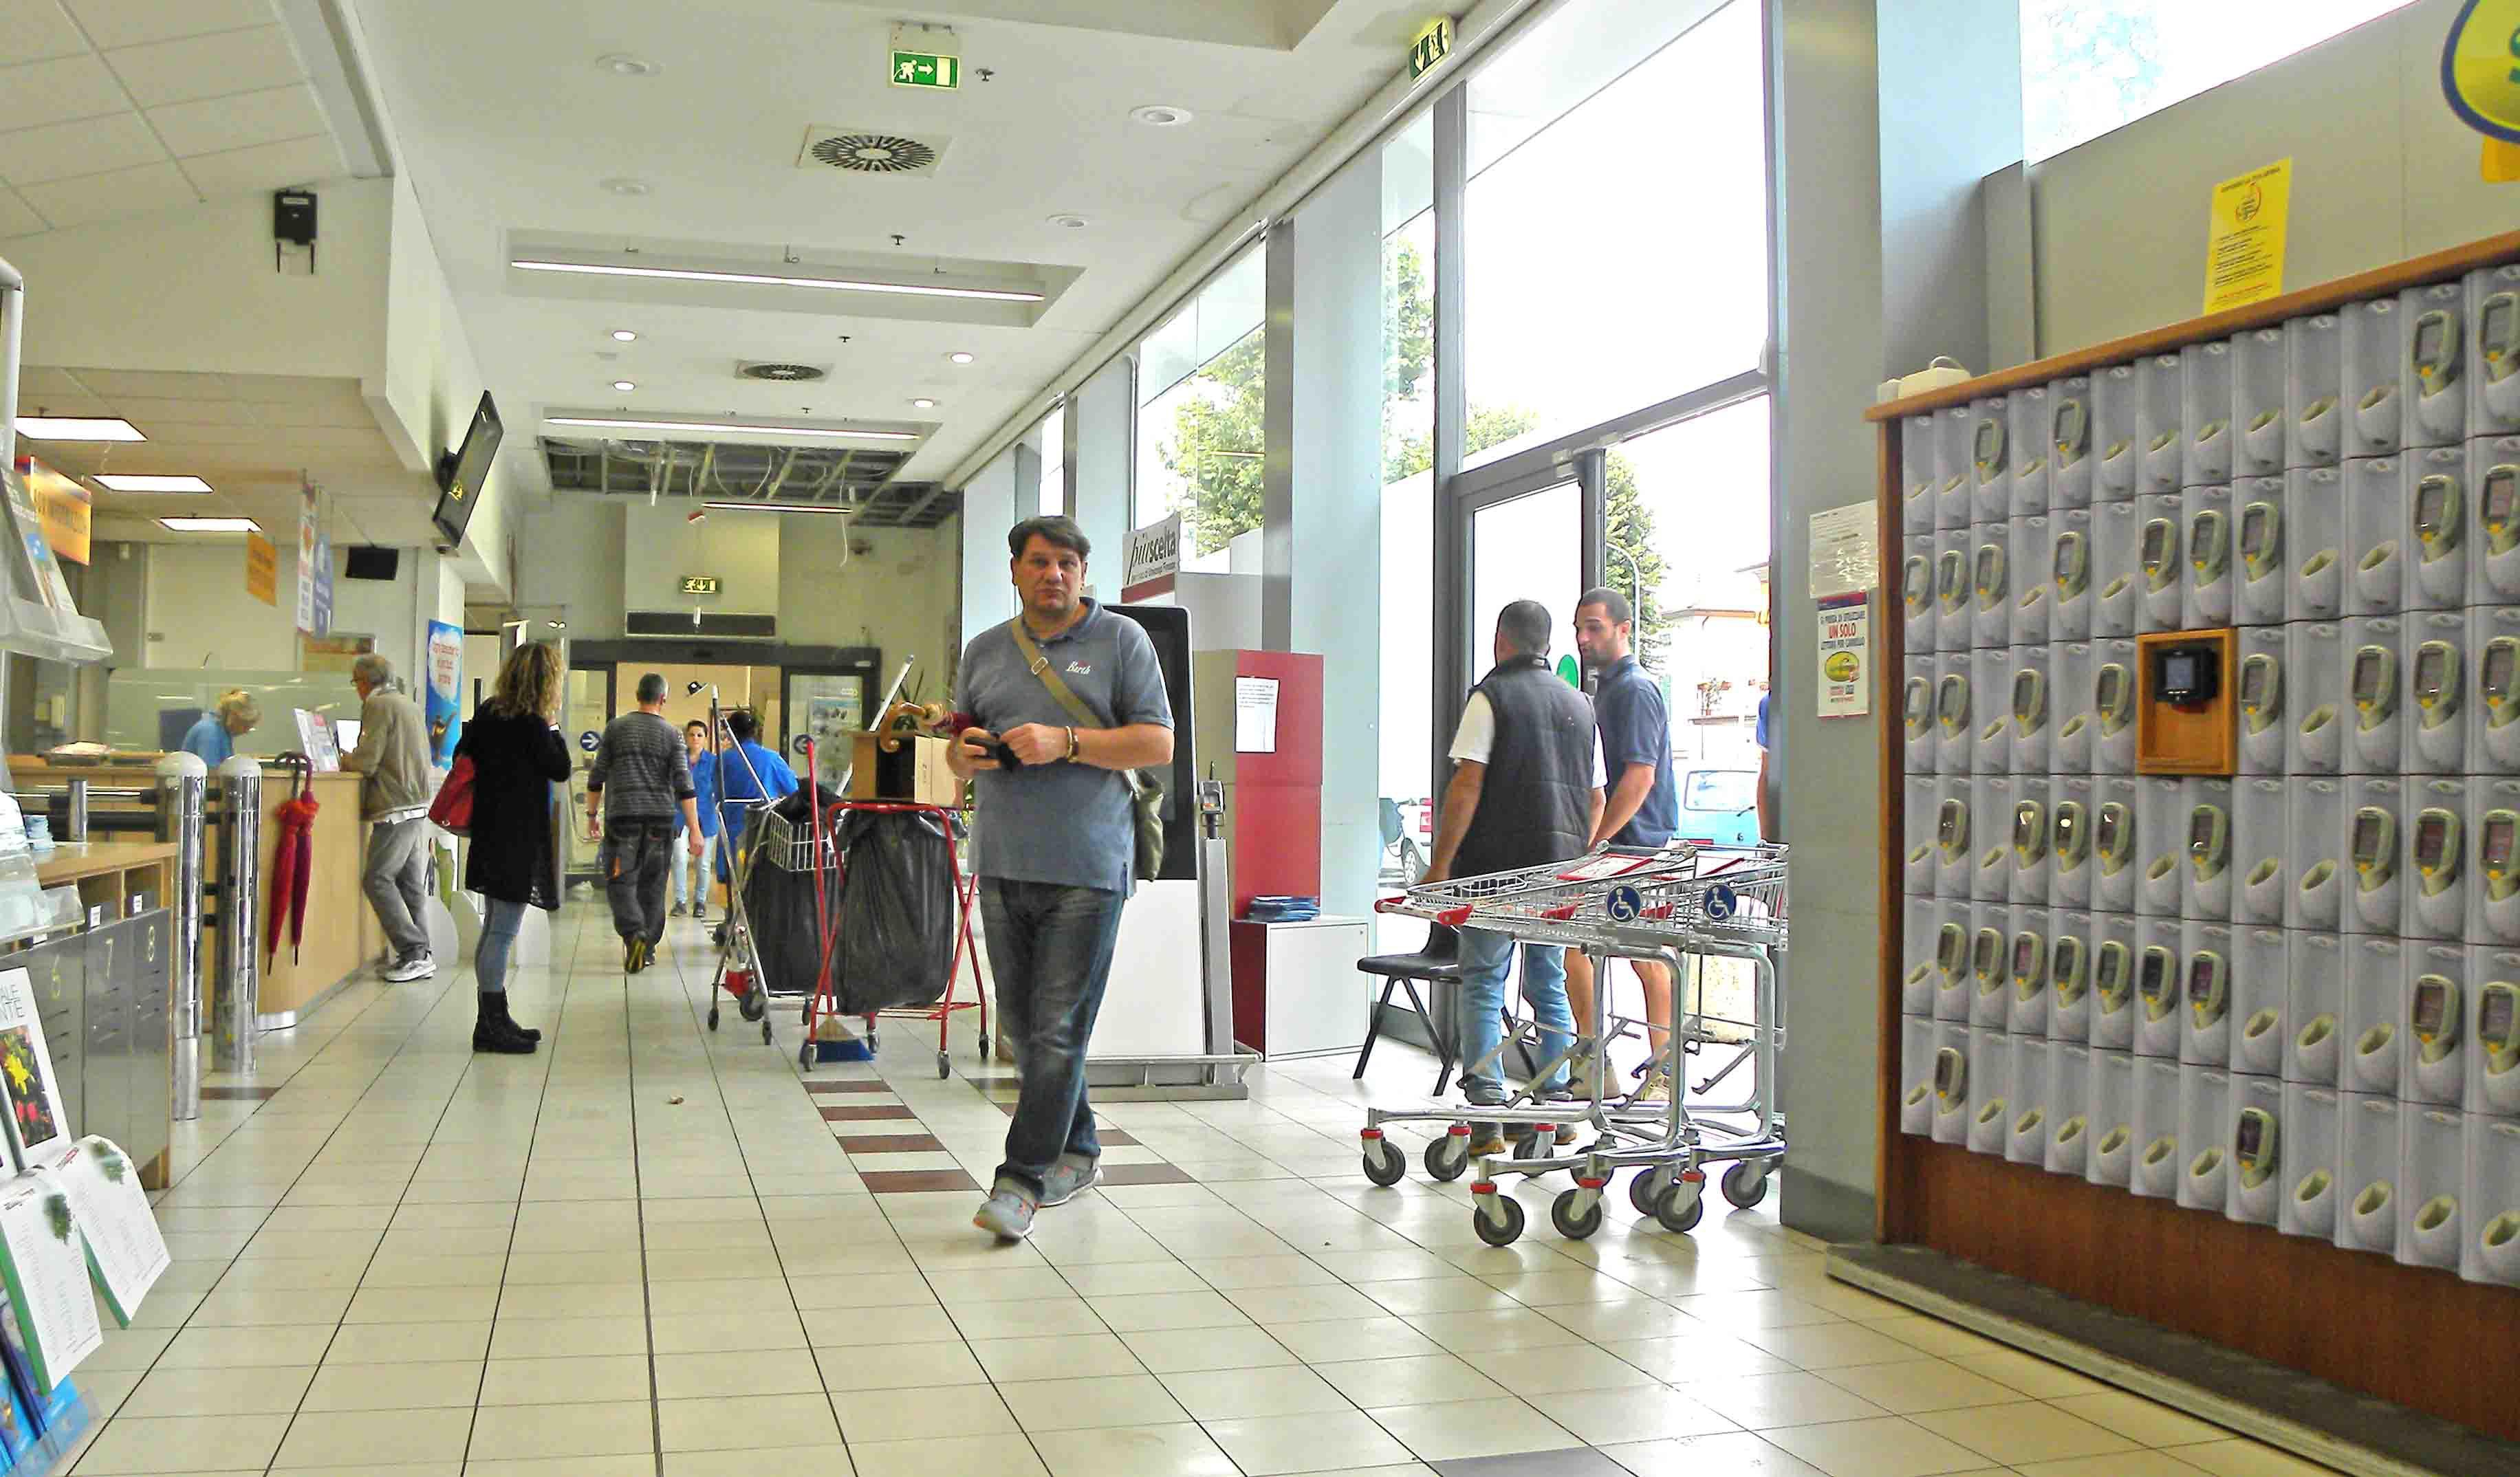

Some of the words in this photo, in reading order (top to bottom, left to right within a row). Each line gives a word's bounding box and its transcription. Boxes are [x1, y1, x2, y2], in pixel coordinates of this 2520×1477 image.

[1829, 625, 1838, 638] UN
[1839, 622, 1856, 637] SOLO
[104, 937, 113, 979] 7
[148, 925, 155, 963] 8
